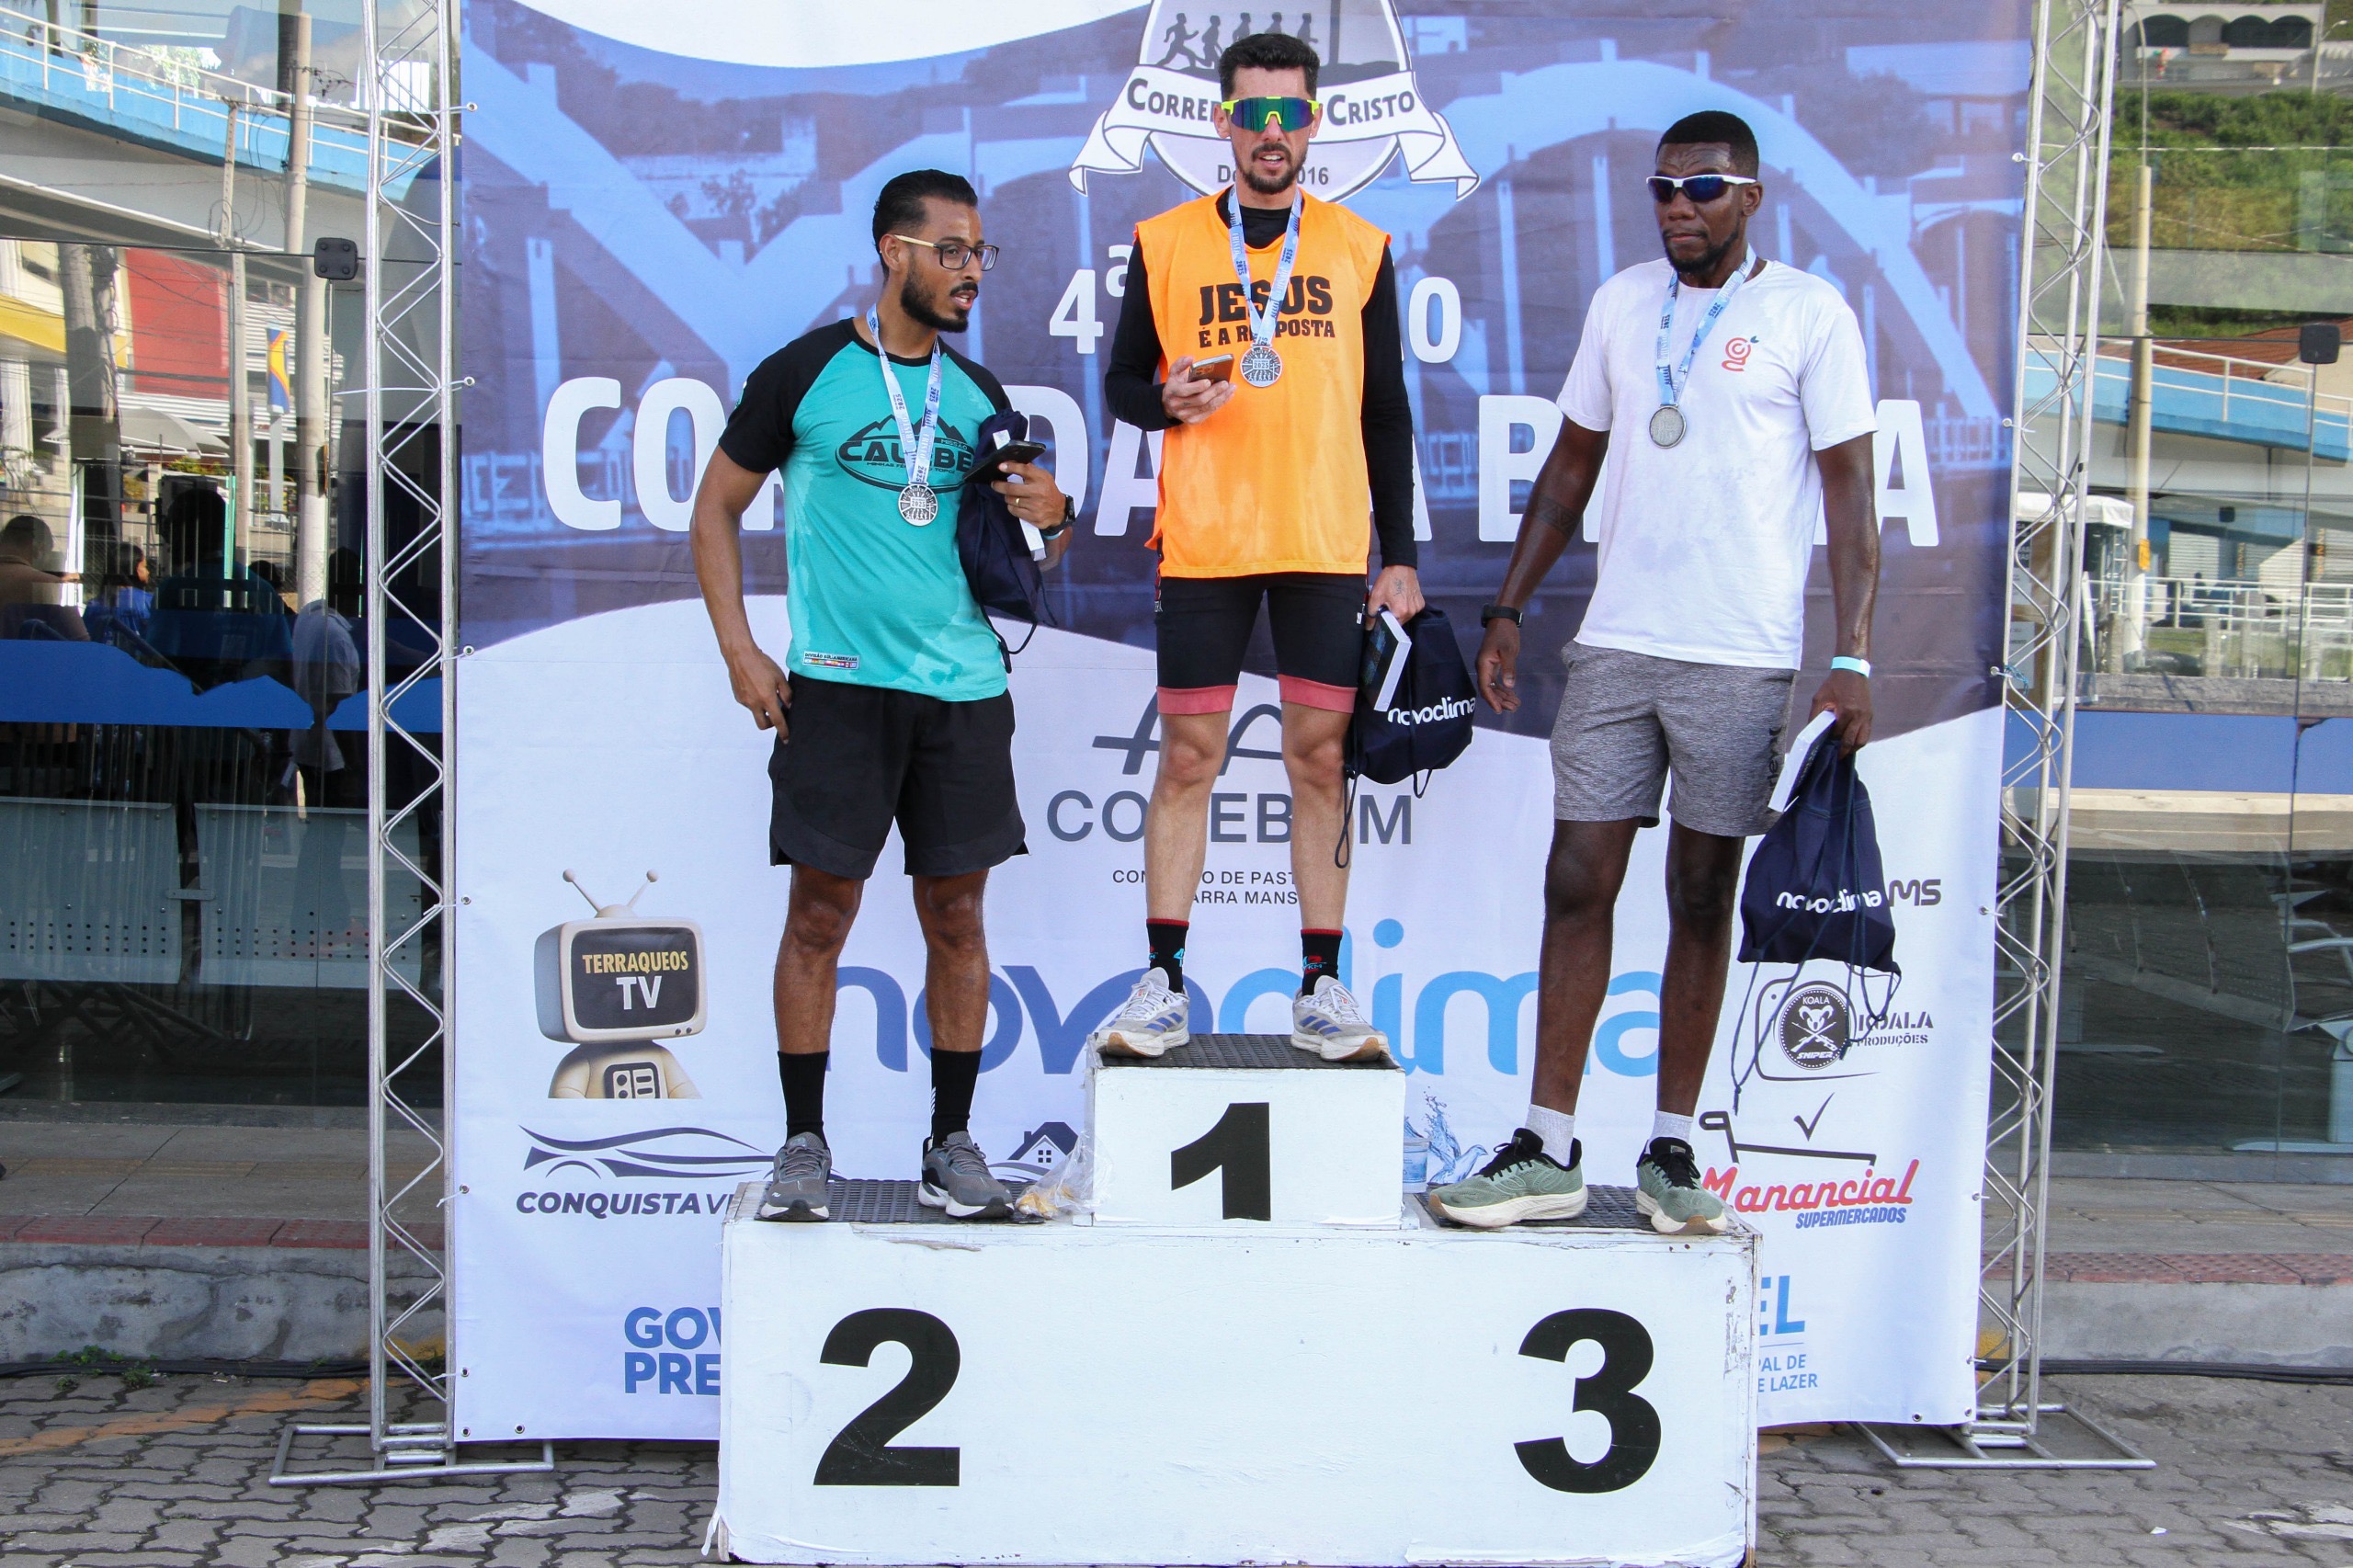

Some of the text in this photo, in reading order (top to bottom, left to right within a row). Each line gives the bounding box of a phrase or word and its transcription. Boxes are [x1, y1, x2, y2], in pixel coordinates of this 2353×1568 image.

[1127, 77, 1415, 126] CORRE CRISTO
[1299, 166, 1329, 185] 016
[1199, 276, 1333, 325] JESUS
[1199, 319, 1336, 348] É A RPOSTA
[929, 387, 938, 402] 2025
[838, 441, 974, 473] CALBE
[1387, 696, 1476, 726] novoclima
[1047, 790, 1412, 845] COEBM
[1221, 871, 1245, 884] DE
[1193, 892, 1298, 904] ARRA MANS
[582, 950, 688, 973] TERRAQUEOS
[616, 975, 662, 1010] TV
[1802, 996, 1830, 1005] KOALA
[1859, 1011, 1934, 1031] KOALA
[1857, 1032, 1928, 1047] PRODUÇÕES
[1797, 1051, 1833, 1060] SNIPER
[1171, 1102, 1270, 1219] 1
[1702, 1158, 1919, 1214] Manancial
[1795, 1207, 1906, 1229] SUPERMERCADOS
[1787, 1354, 1806, 1369] DE
[1770, 1373, 1818, 1392] LAZER
[813, 1308, 960, 1486] 2
[1514, 1308, 1661, 1494] 3
